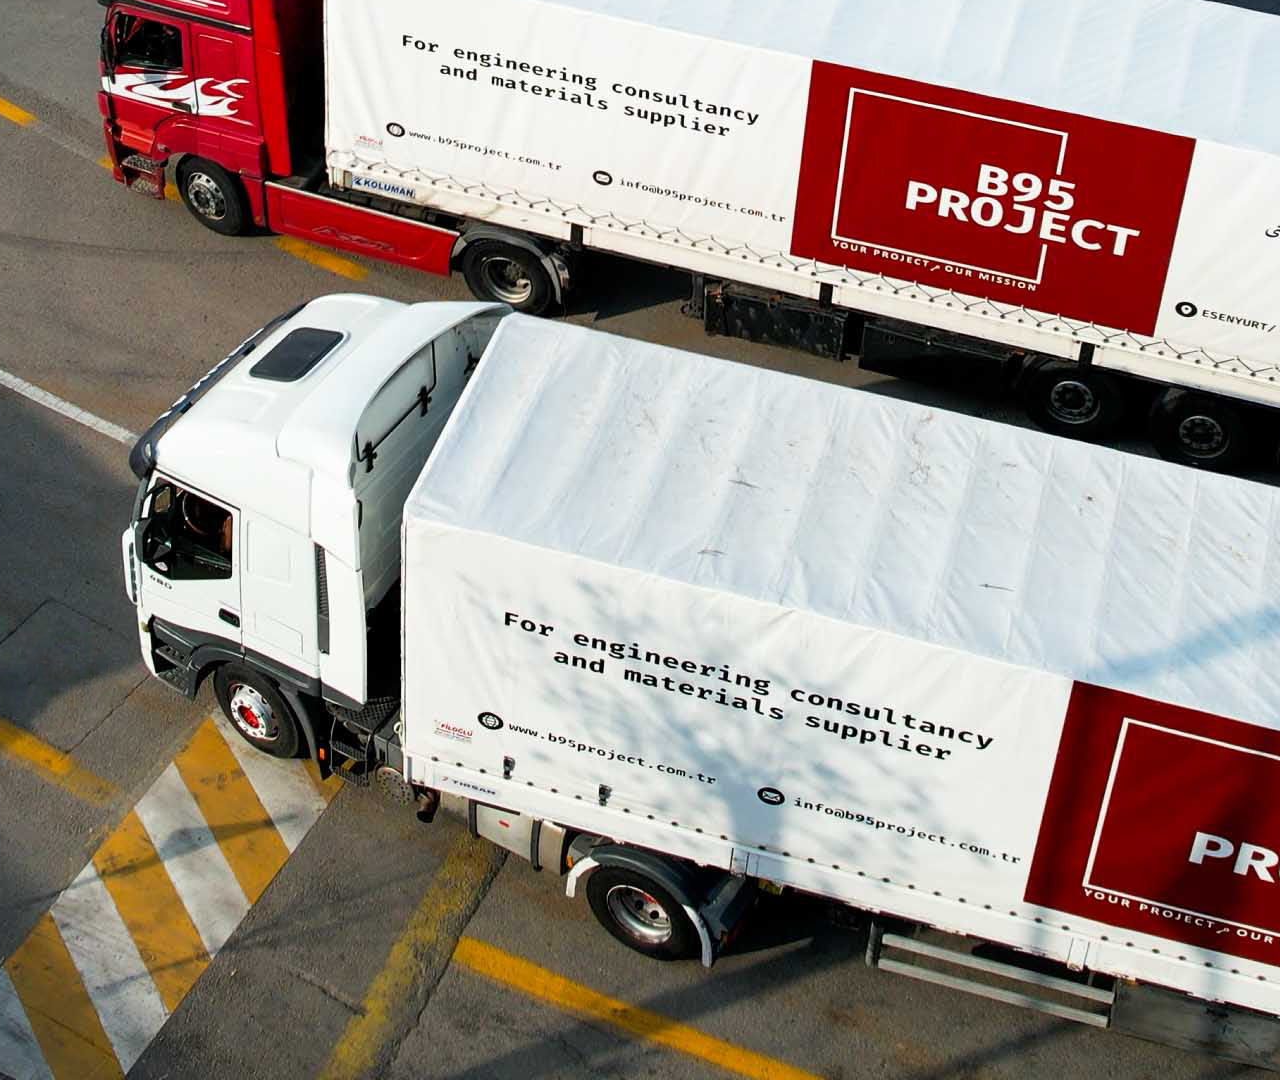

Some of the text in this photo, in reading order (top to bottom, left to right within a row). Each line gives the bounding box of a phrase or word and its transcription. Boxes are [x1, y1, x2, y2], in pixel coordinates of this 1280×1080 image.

[402, 35, 759, 127] For engineering consultancy
[439, 63, 730, 137] and materials supplier
[408, 131, 562, 171] www.b95project.com.tr
[364, 179, 414, 197] KOLUMAN
[620, 179, 787, 223] info@b95project.com.tr
[977, 164, 1076, 211] B95
[905, 180, 1140, 257] PROJECT
[832, 239, 1037, 291] YOUR PROJECT OUR MISSION
[1202, 309, 1276, 333] ESENYURT/
[504, 612, 994, 750] For engineering consultancy
[553, 648, 952, 761] and materials supplier
[508, 723, 716, 784] www.b95project.com.tr
[794, 797, 1021, 864] info@b95project.com.tr
[1083, 889, 1131, 909] YOUR
[1139, 903, 1215, 928] PROJECT
[1236, 928, 1274, 945] OUR
